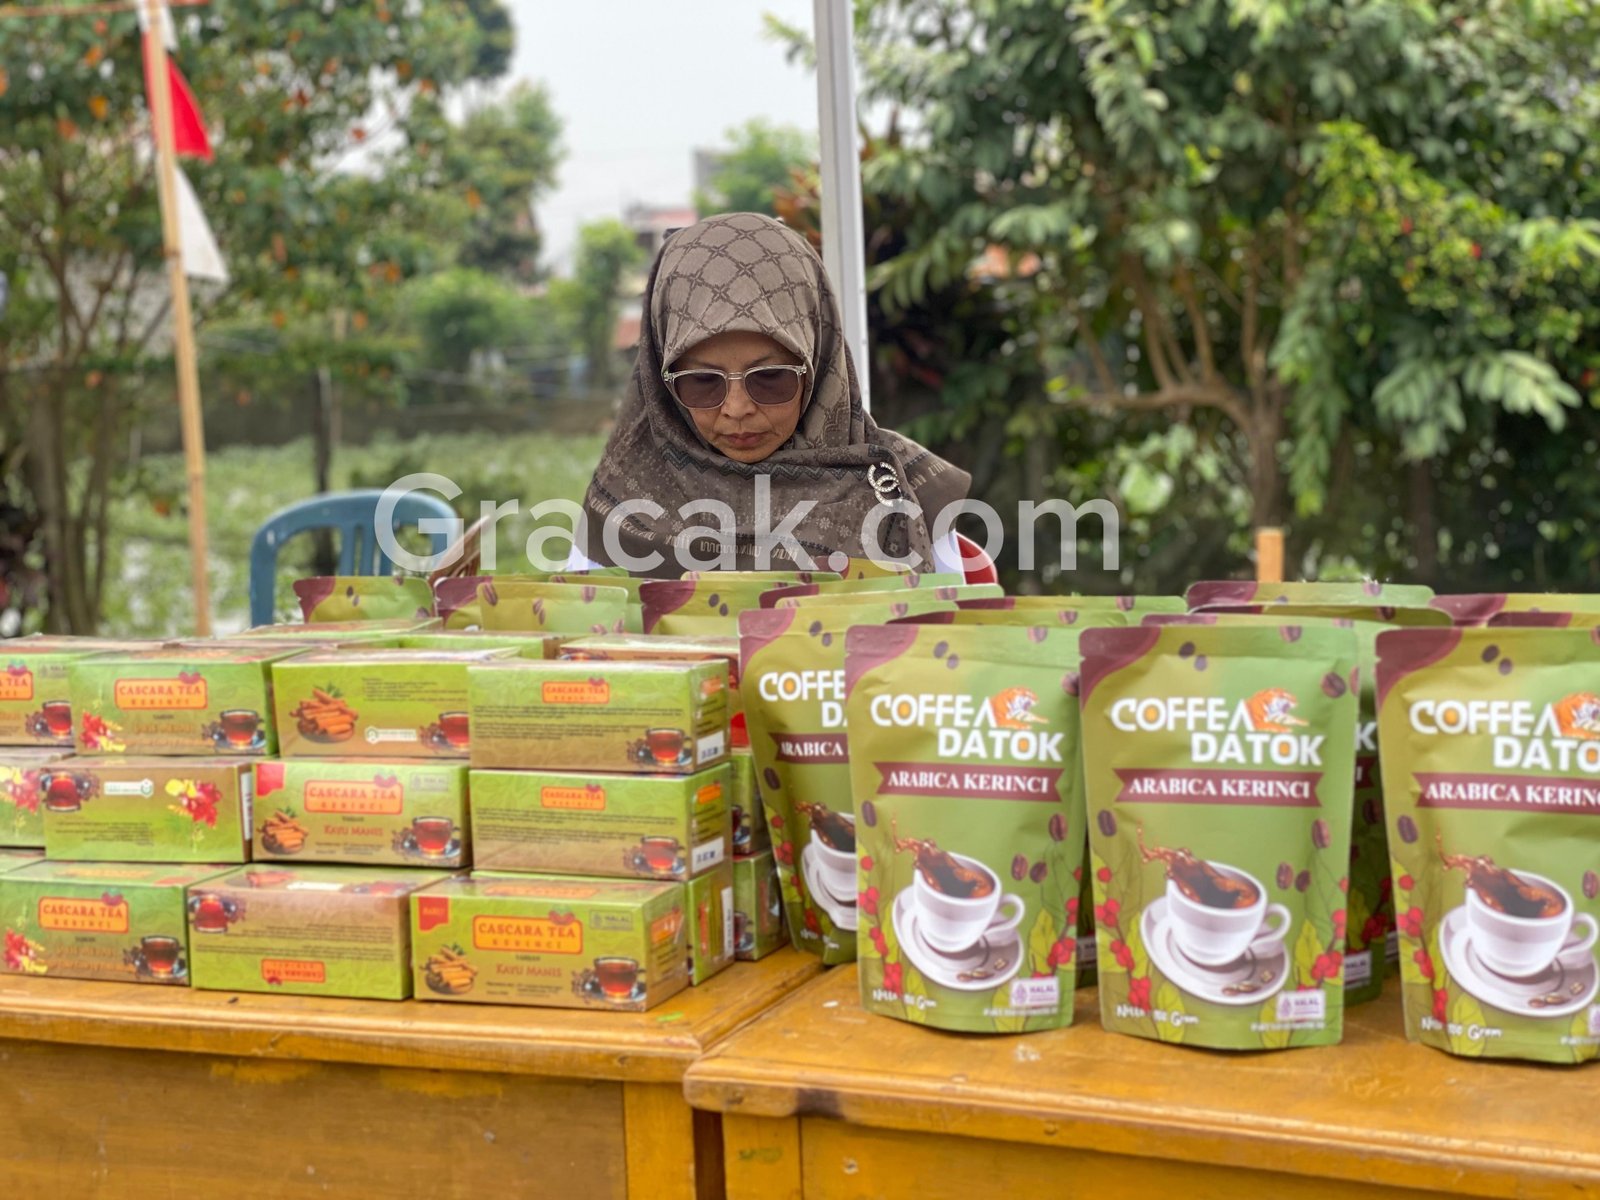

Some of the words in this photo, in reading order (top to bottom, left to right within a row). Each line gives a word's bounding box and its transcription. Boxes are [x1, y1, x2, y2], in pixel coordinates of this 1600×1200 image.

[177, 685, 202, 695] TEA
[759, 670, 846, 701] COFFE
[870, 694, 998, 728] COFFEA
[1111, 697, 1256, 732] COFFEA
[1409, 700, 1562, 737] COFFEA
[781, 741, 844, 757] ARABICA
[938, 728, 1065, 762] DATOK
[1191, 732, 1325, 766] DATOK
[1493, 736, 1600, 773] DATO
[309, 787, 368, 800] CASCARA
[371, 789, 397, 800] TEA
[888, 770, 960, 790] ARABICA
[963, 772, 1049, 793] KERINCI
[1129, 777, 1217, 796] ARABICA
[1221, 779, 1310, 799] KERINCI
[1425, 781, 1521, 803] ARABICA
[1526, 784, 1600, 807] KERIN
[43, 904, 96, 917] CASCARA
[99, 906, 123, 918] TEA
[478, 922, 543, 937] CASCARA
[547, 925, 577, 939] TEA
